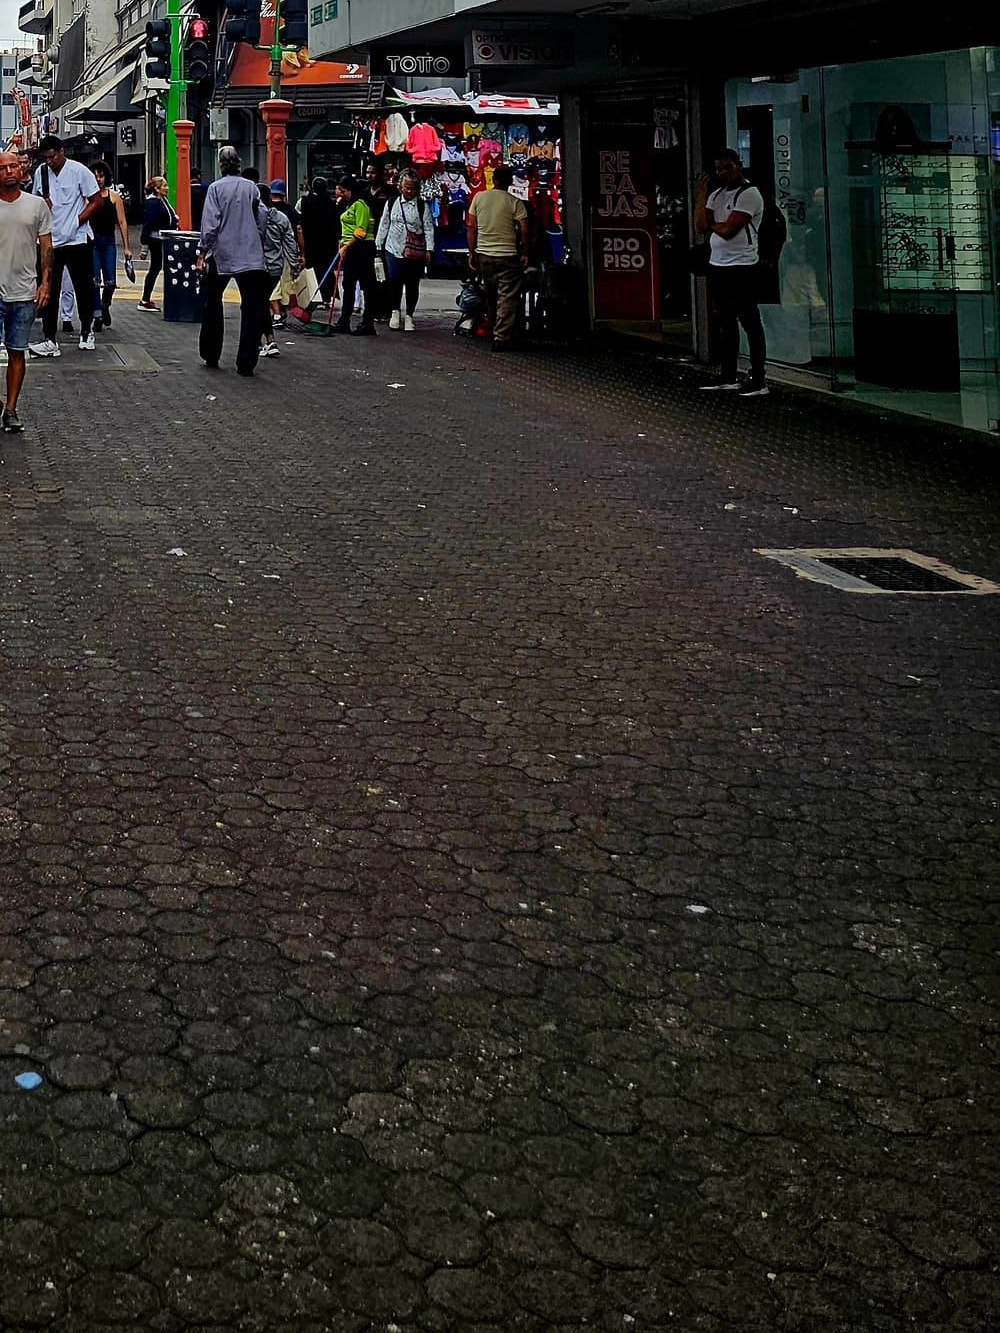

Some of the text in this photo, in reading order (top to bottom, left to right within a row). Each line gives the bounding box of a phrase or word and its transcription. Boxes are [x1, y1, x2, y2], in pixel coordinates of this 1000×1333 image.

[387, 55, 450, 73] TOTTO
[777, 134, 791, 210] OPTICAS
[598, 195, 649, 217] JAS
[603, 238, 640, 252] 2DO
[603, 254, 645, 268] PISO
